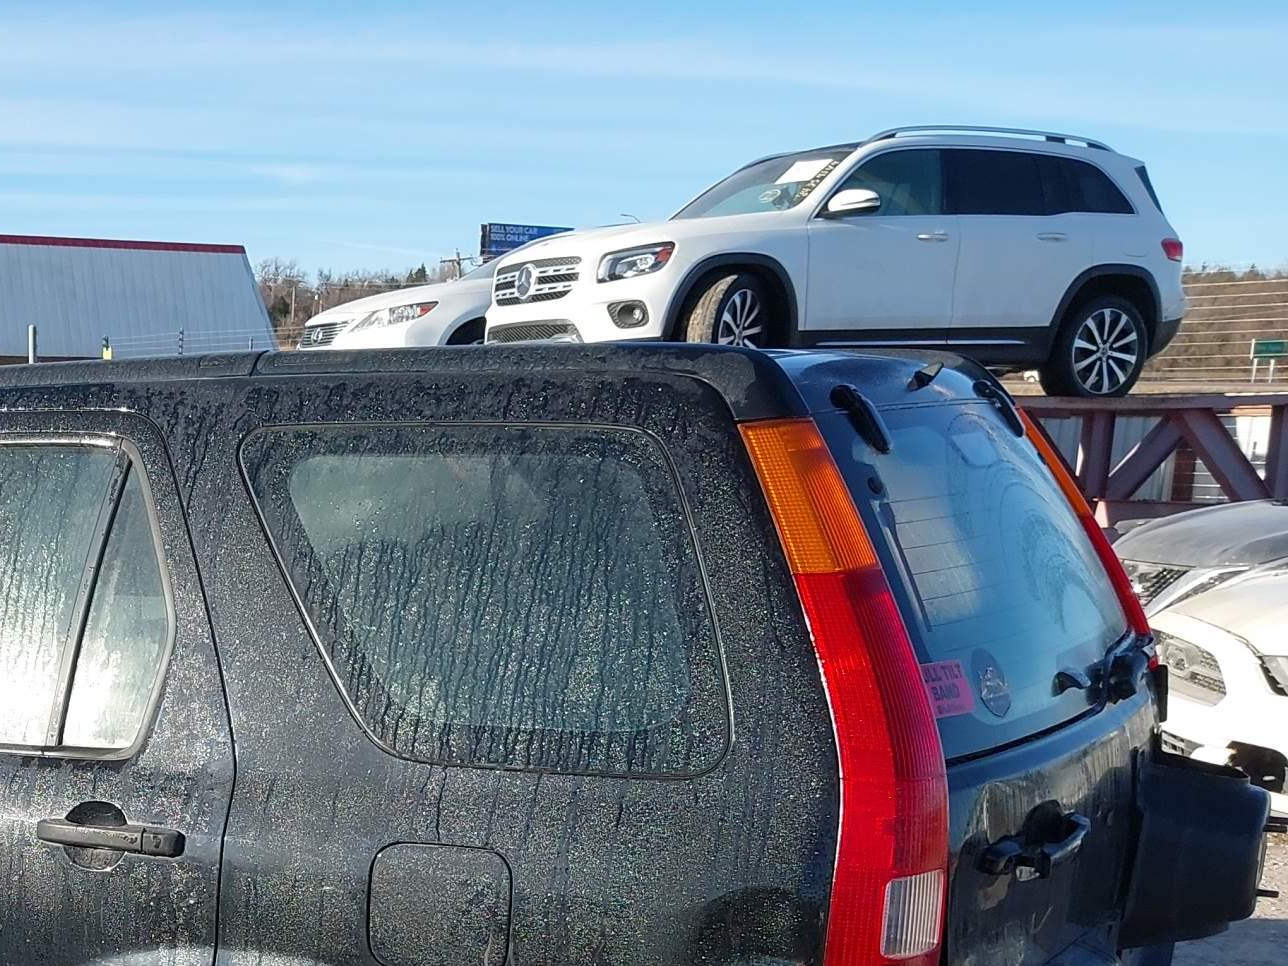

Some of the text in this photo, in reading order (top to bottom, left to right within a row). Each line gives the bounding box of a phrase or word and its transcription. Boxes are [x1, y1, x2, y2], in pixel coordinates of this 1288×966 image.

[491, 225, 538, 235] SELL YOUR CAR
